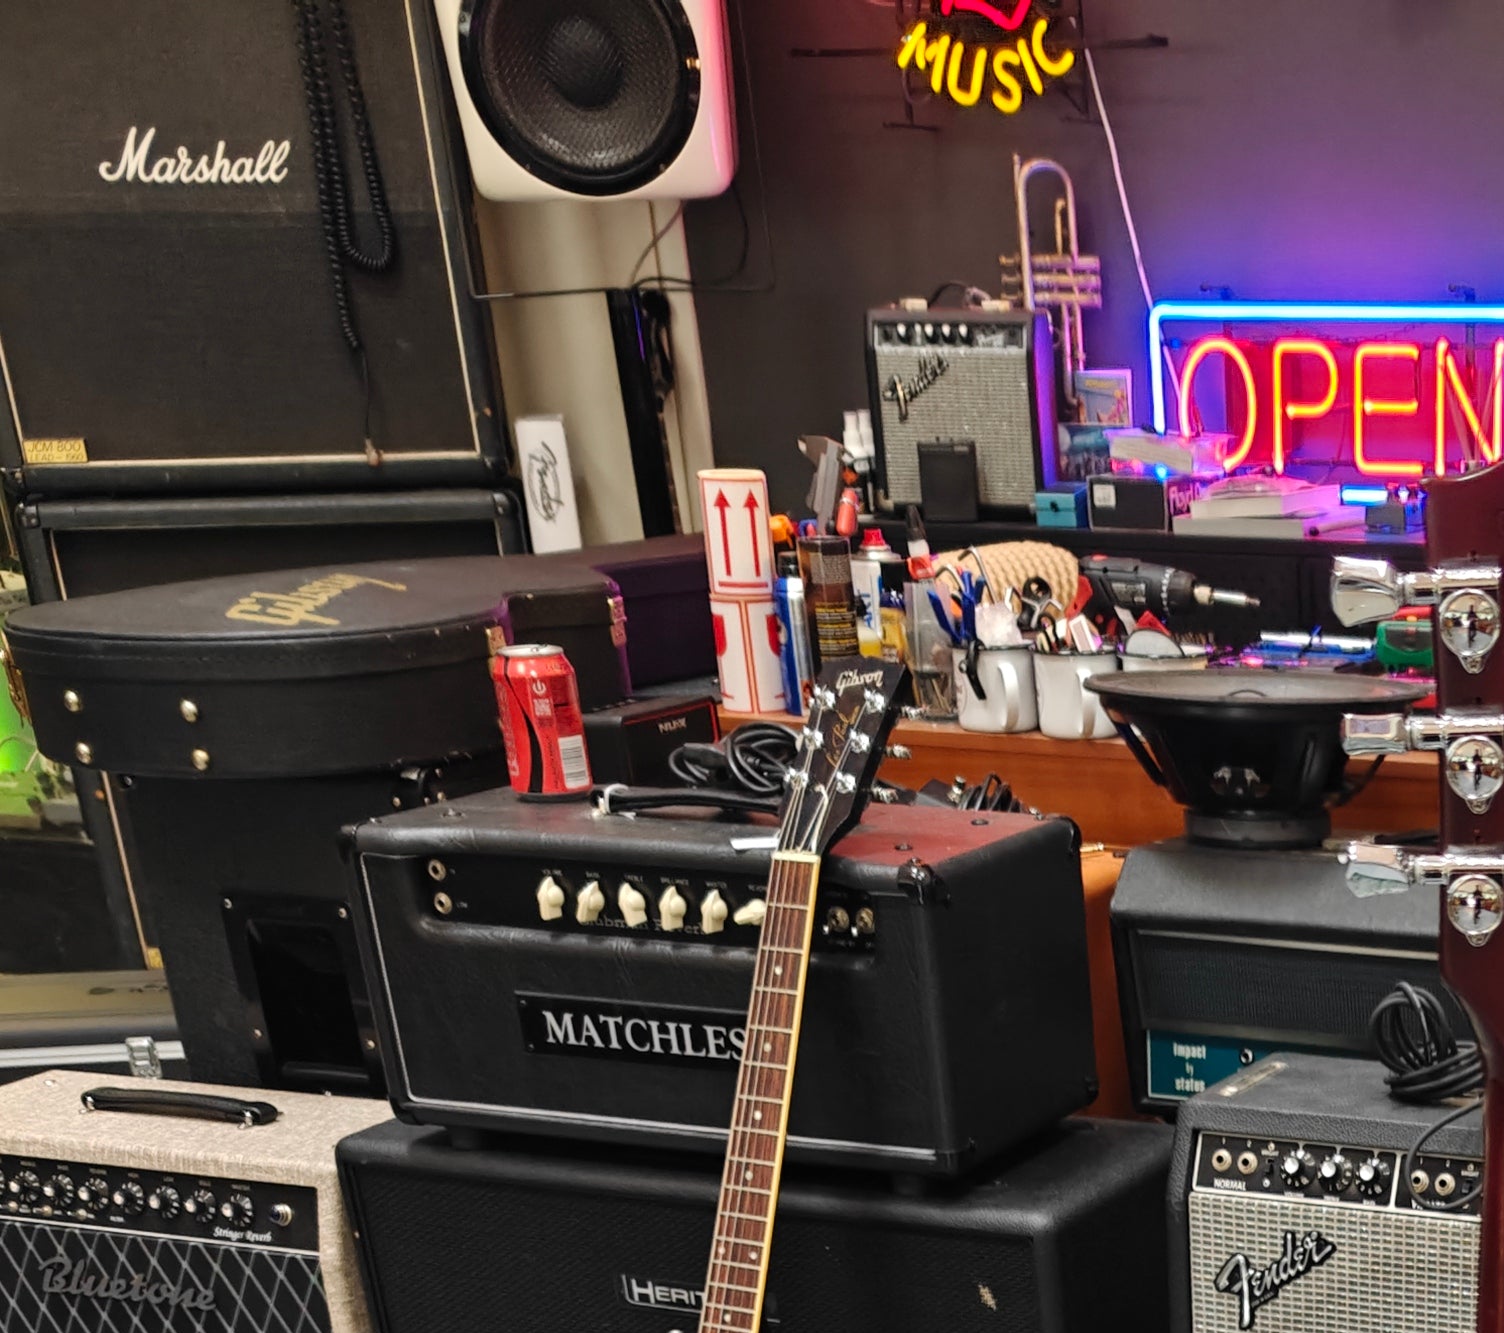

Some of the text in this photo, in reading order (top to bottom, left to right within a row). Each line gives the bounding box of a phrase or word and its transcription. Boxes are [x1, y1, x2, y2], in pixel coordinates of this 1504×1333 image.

[898, 18, 1075, 115] MUSIC
[100, 126, 291, 184] Marshall
[882, 350, 950, 424] Fender
[28, 440, 82, 453] JCM 800
[225, 573, 407, 626] Gibson
[836, 669, 884, 697] Gibson
[1173, 1042, 1206, 1059] Impact
[1185, 1062, 1194, 1076] by
[1213, 1178, 1247, 1191] NORMAL
[213, 1226, 273, 1243] Stringer Reverb
[38, 1256, 216, 1311] Bluetone
[1214, 1231, 1337, 1330] Fender
